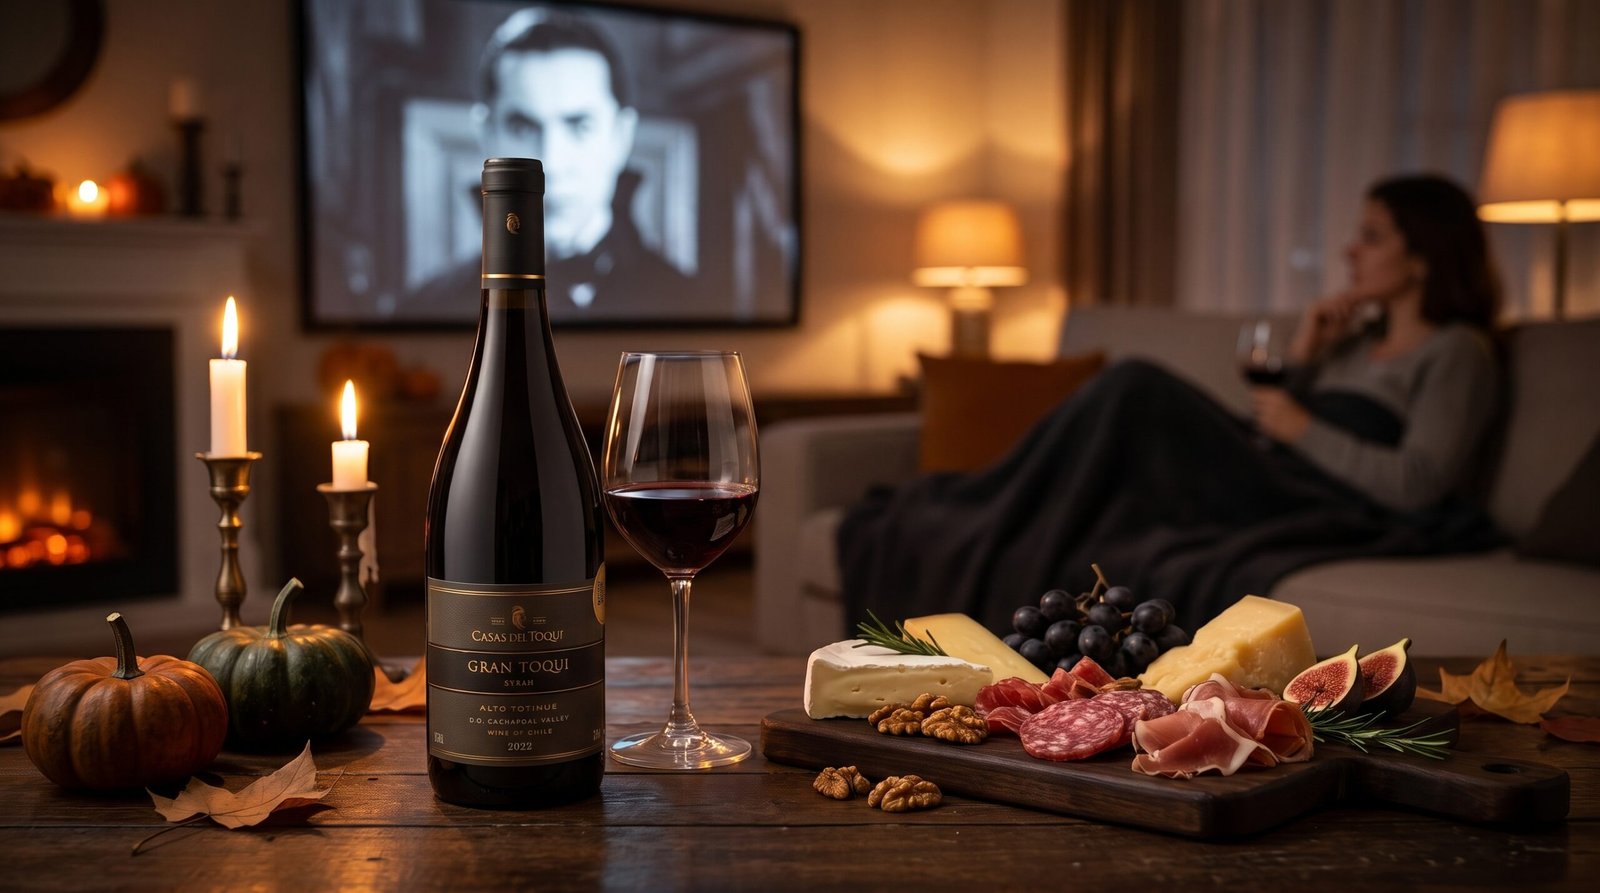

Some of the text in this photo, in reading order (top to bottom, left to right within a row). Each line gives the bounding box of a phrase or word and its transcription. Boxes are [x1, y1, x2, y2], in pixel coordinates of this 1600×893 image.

[471, 630, 564, 643] CASAS DEL TOQUI
[467, 658, 569, 674] GRAN TOQUI
[504, 679, 534, 687] SYRAH
[479, 703, 558, 712] ALTO TOTINUE
[541, 714, 570, 723] VALLEY
[527, 728, 553, 736] CHILE
[507, 742, 533, 751] 2022
